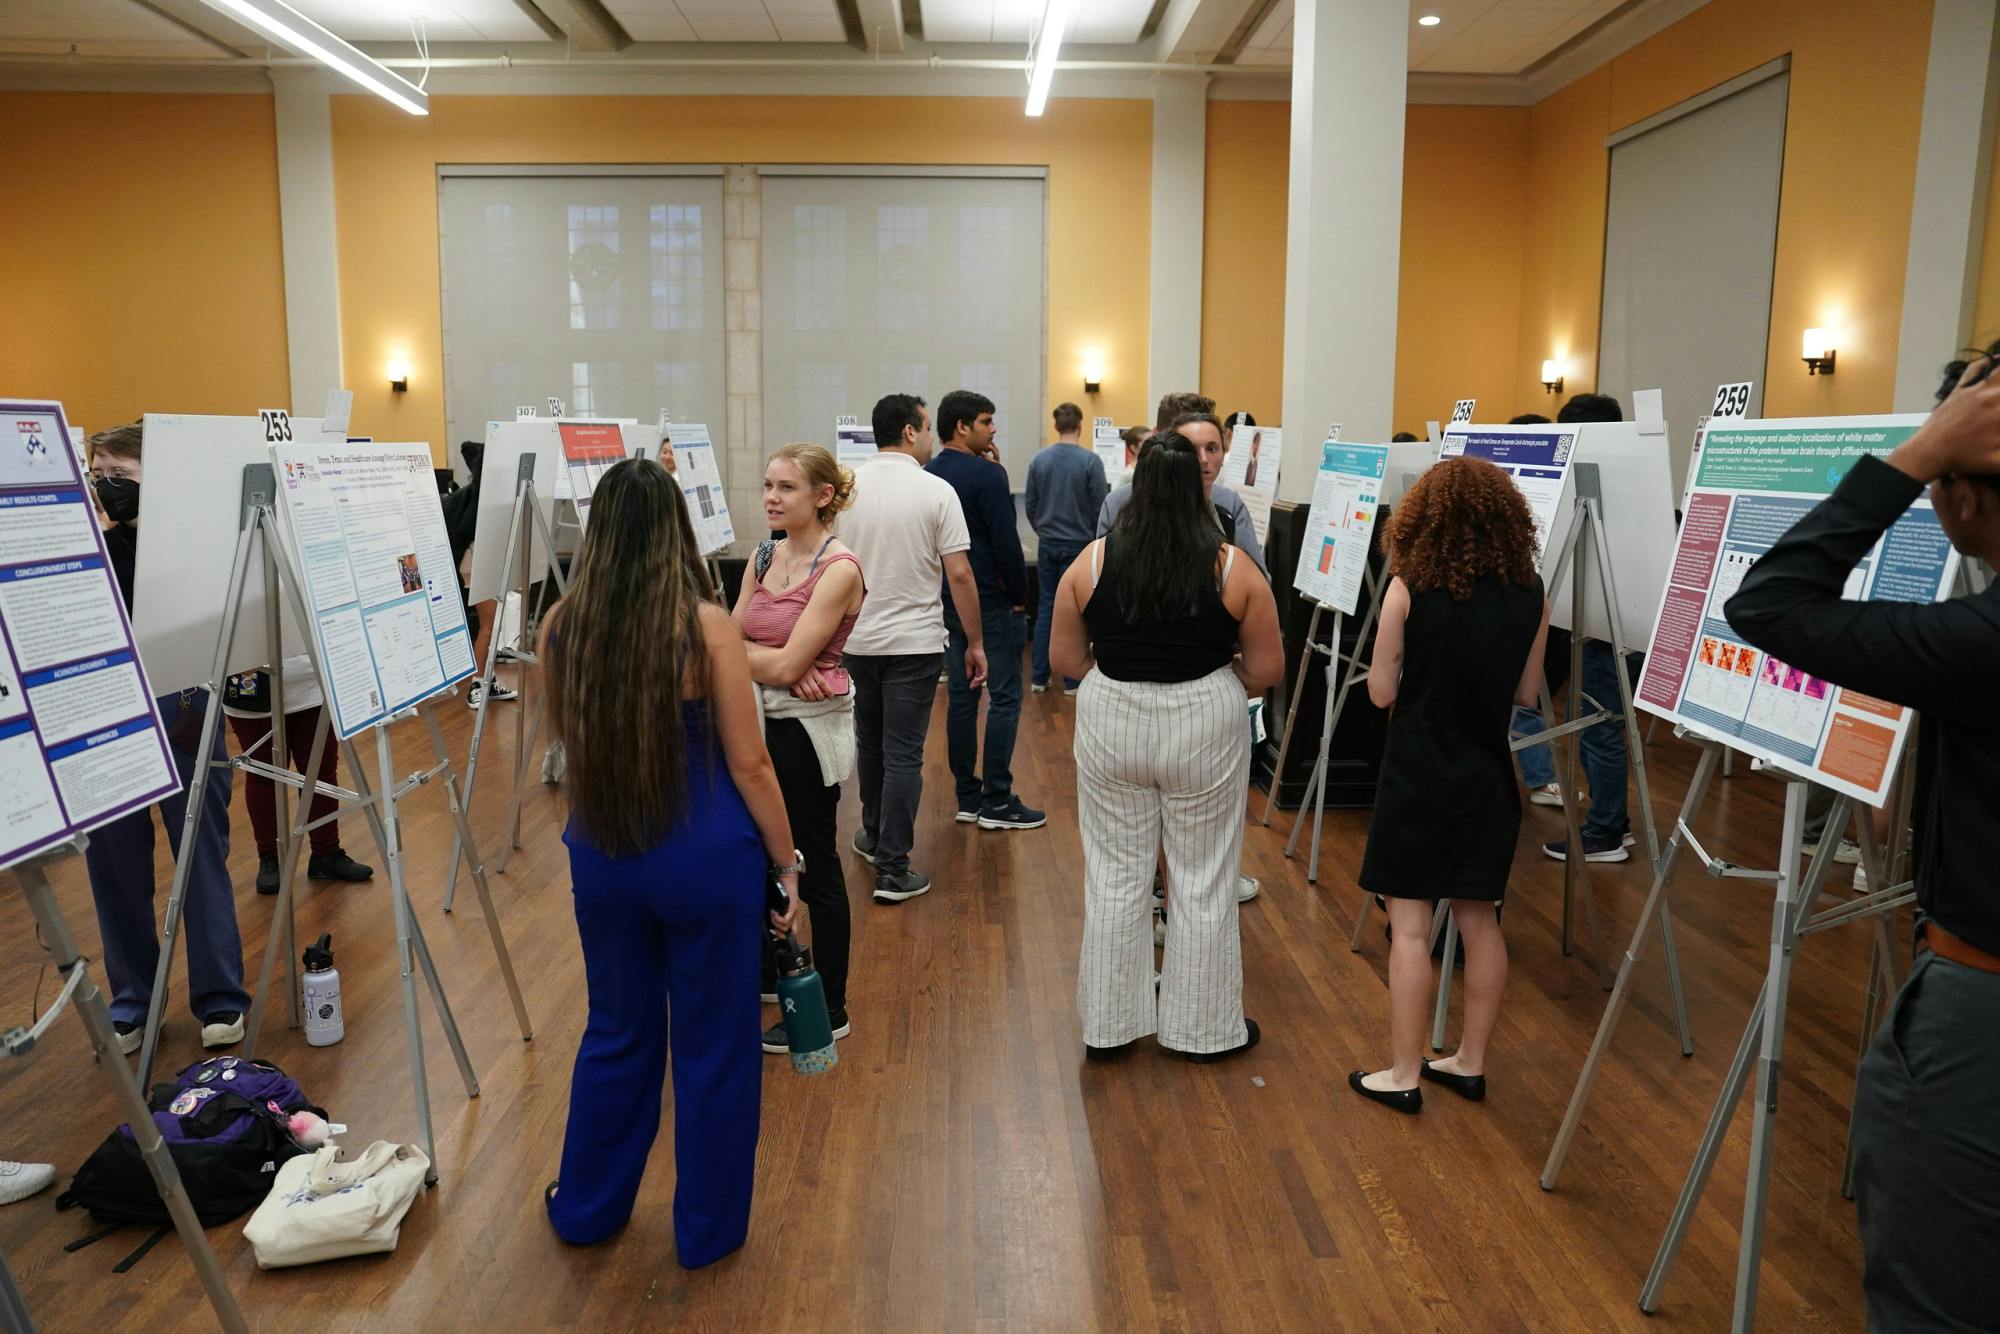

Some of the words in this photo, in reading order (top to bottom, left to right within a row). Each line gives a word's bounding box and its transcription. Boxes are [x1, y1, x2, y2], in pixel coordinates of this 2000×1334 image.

[1713, 385, 1749, 417] 259
[518, 407, 535, 416] 307
[1453, 401, 1474, 421] 258
[261, 411, 292, 441] 253
[1095, 418, 1112, 427] 309
[1767, 433, 1778, 442] and
[1778, 433, 1800, 445] auditory
[1801, 432, 1836, 442] localization
[1836, 432, 1845, 442] of
[1845, 432, 1862, 442] white
[1862, 432, 1886, 442] matter
[1743, 446, 1750, 455] of
[1749, 446, 1758, 455] the
[1779, 446, 1799, 455] human
[1799, 446, 1815, 455] brain
[1815, 446, 1840, 458] through
[1841, 446, 1871, 456] diffusion
[86, 729, 119, 746] REFERENCES
